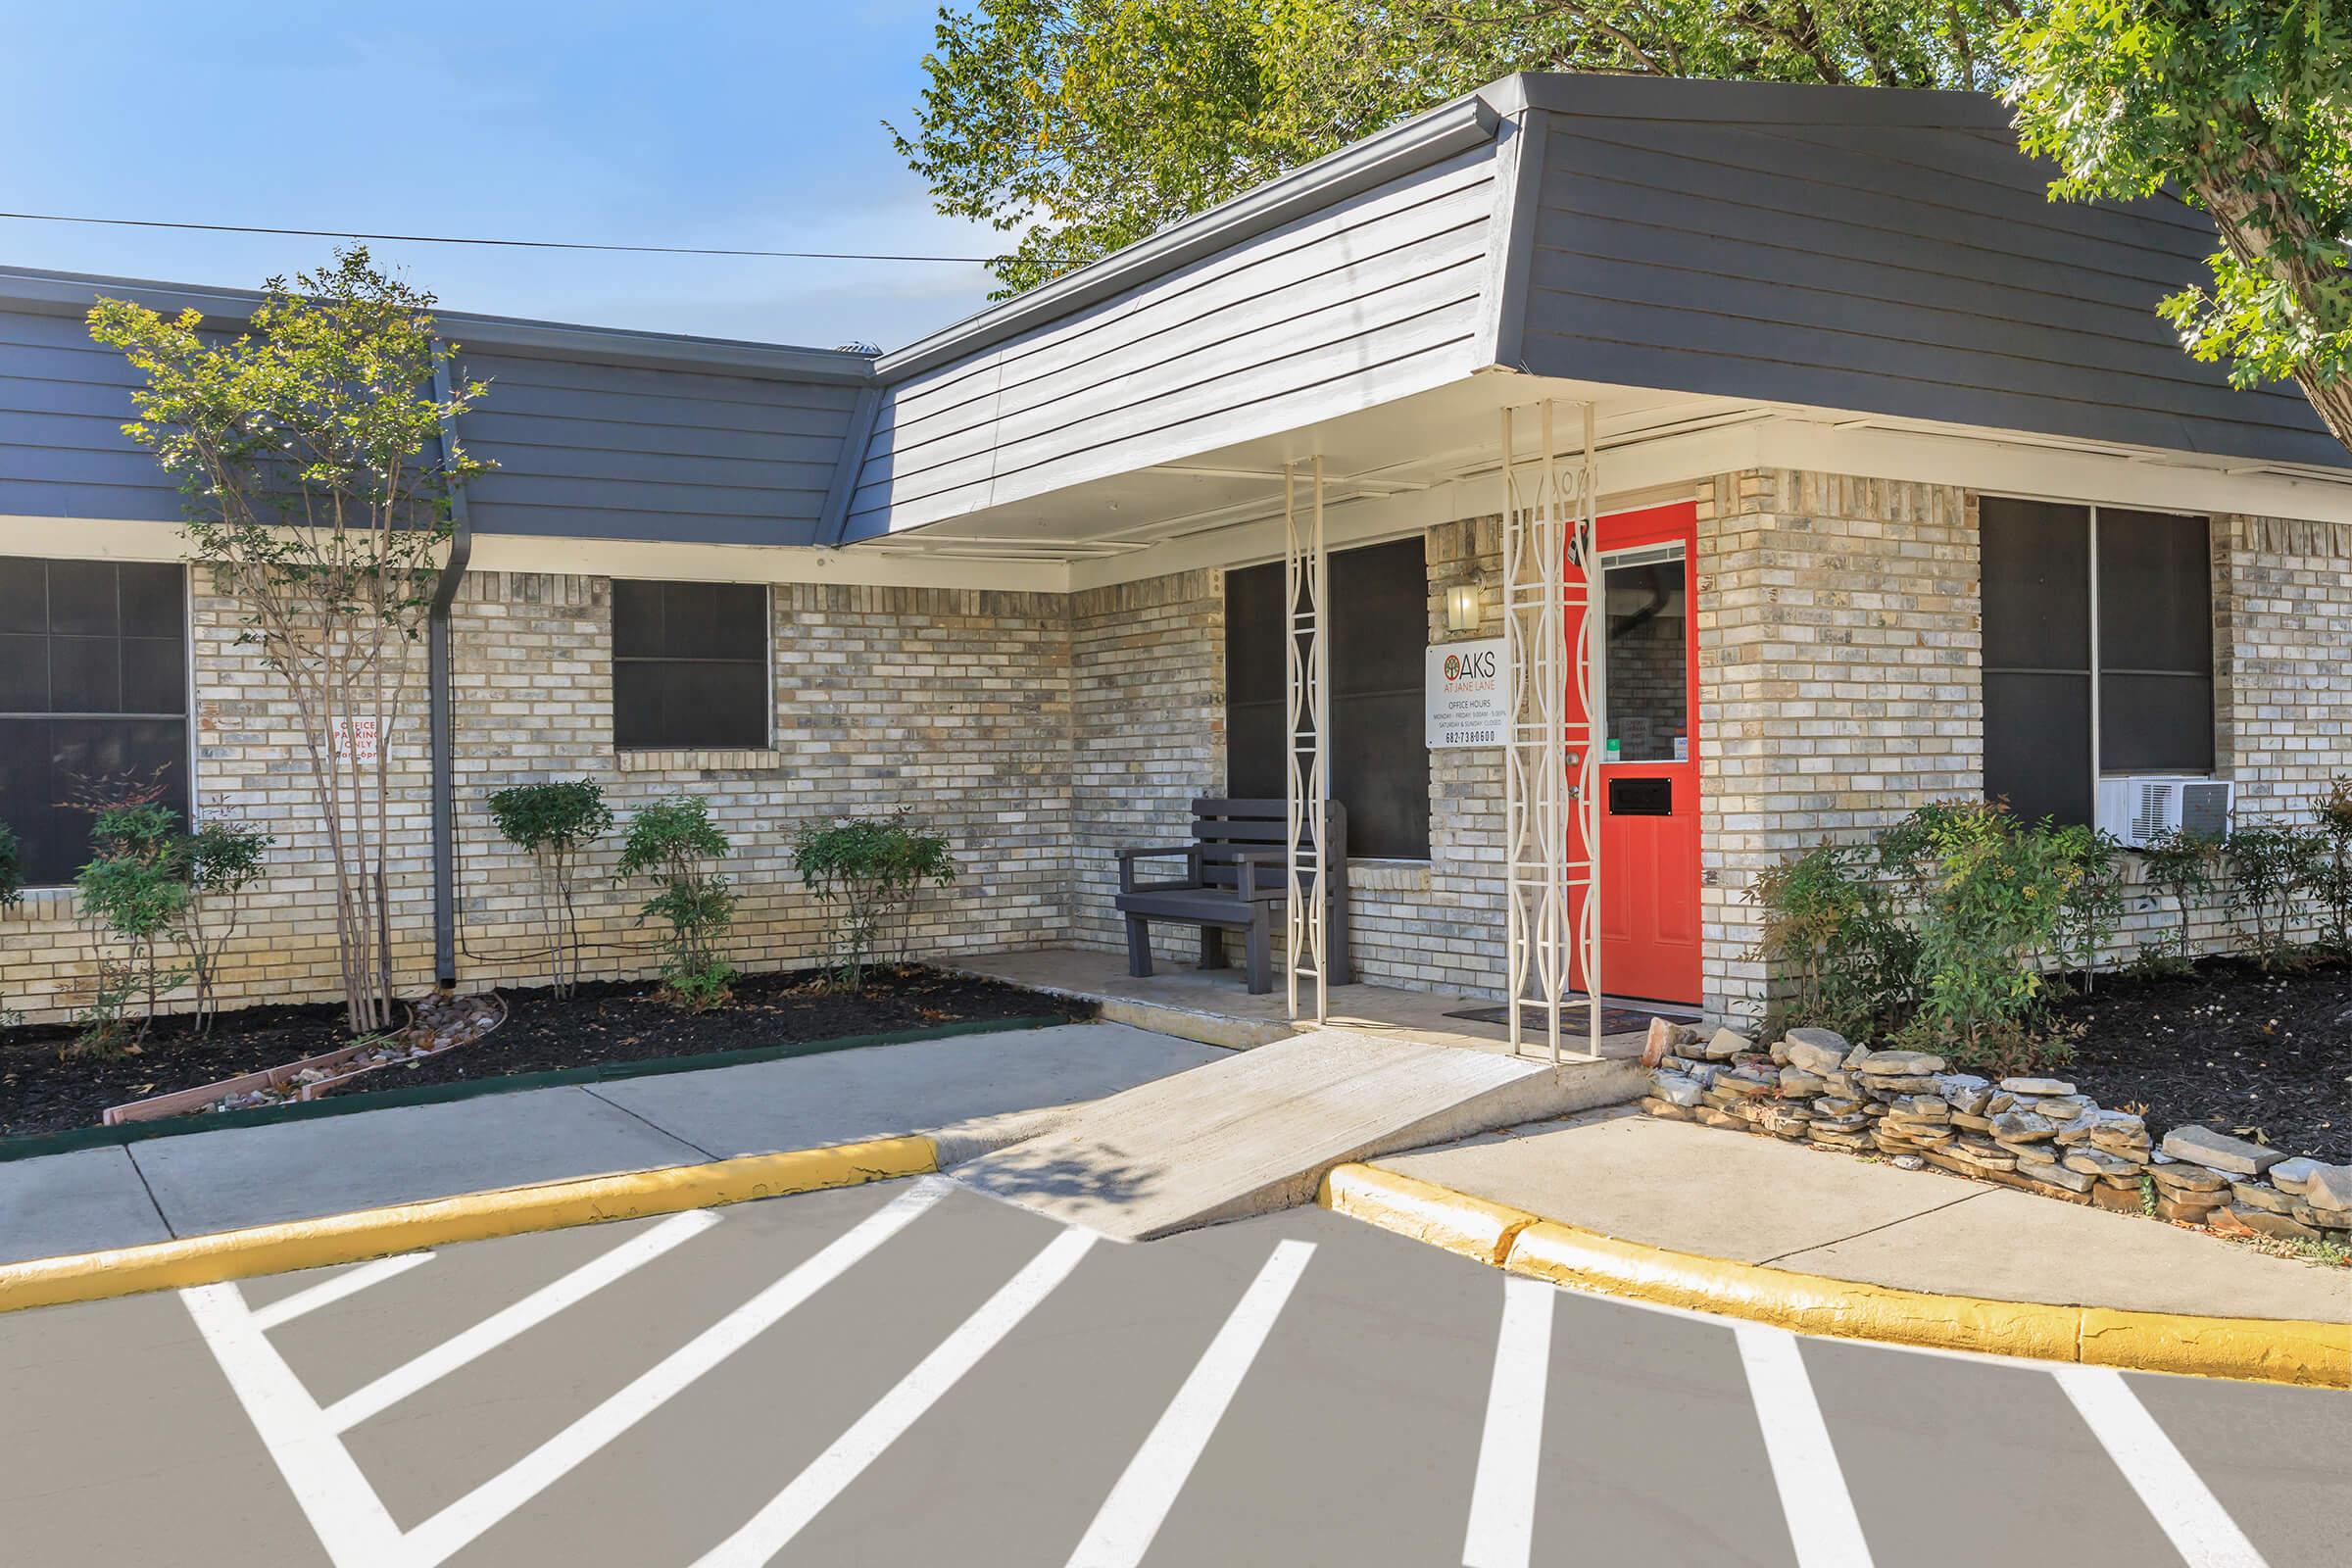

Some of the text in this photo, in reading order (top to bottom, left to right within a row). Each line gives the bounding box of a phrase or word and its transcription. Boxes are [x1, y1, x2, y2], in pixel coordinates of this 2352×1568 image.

[1444, 651, 1495, 681] OAKS
[1445, 679, 1495, 693] AT JANE LANE
[1448, 699, 1491, 710] OFFICE HOURS
[1446, 730, 1494, 744] 682-738-0600
